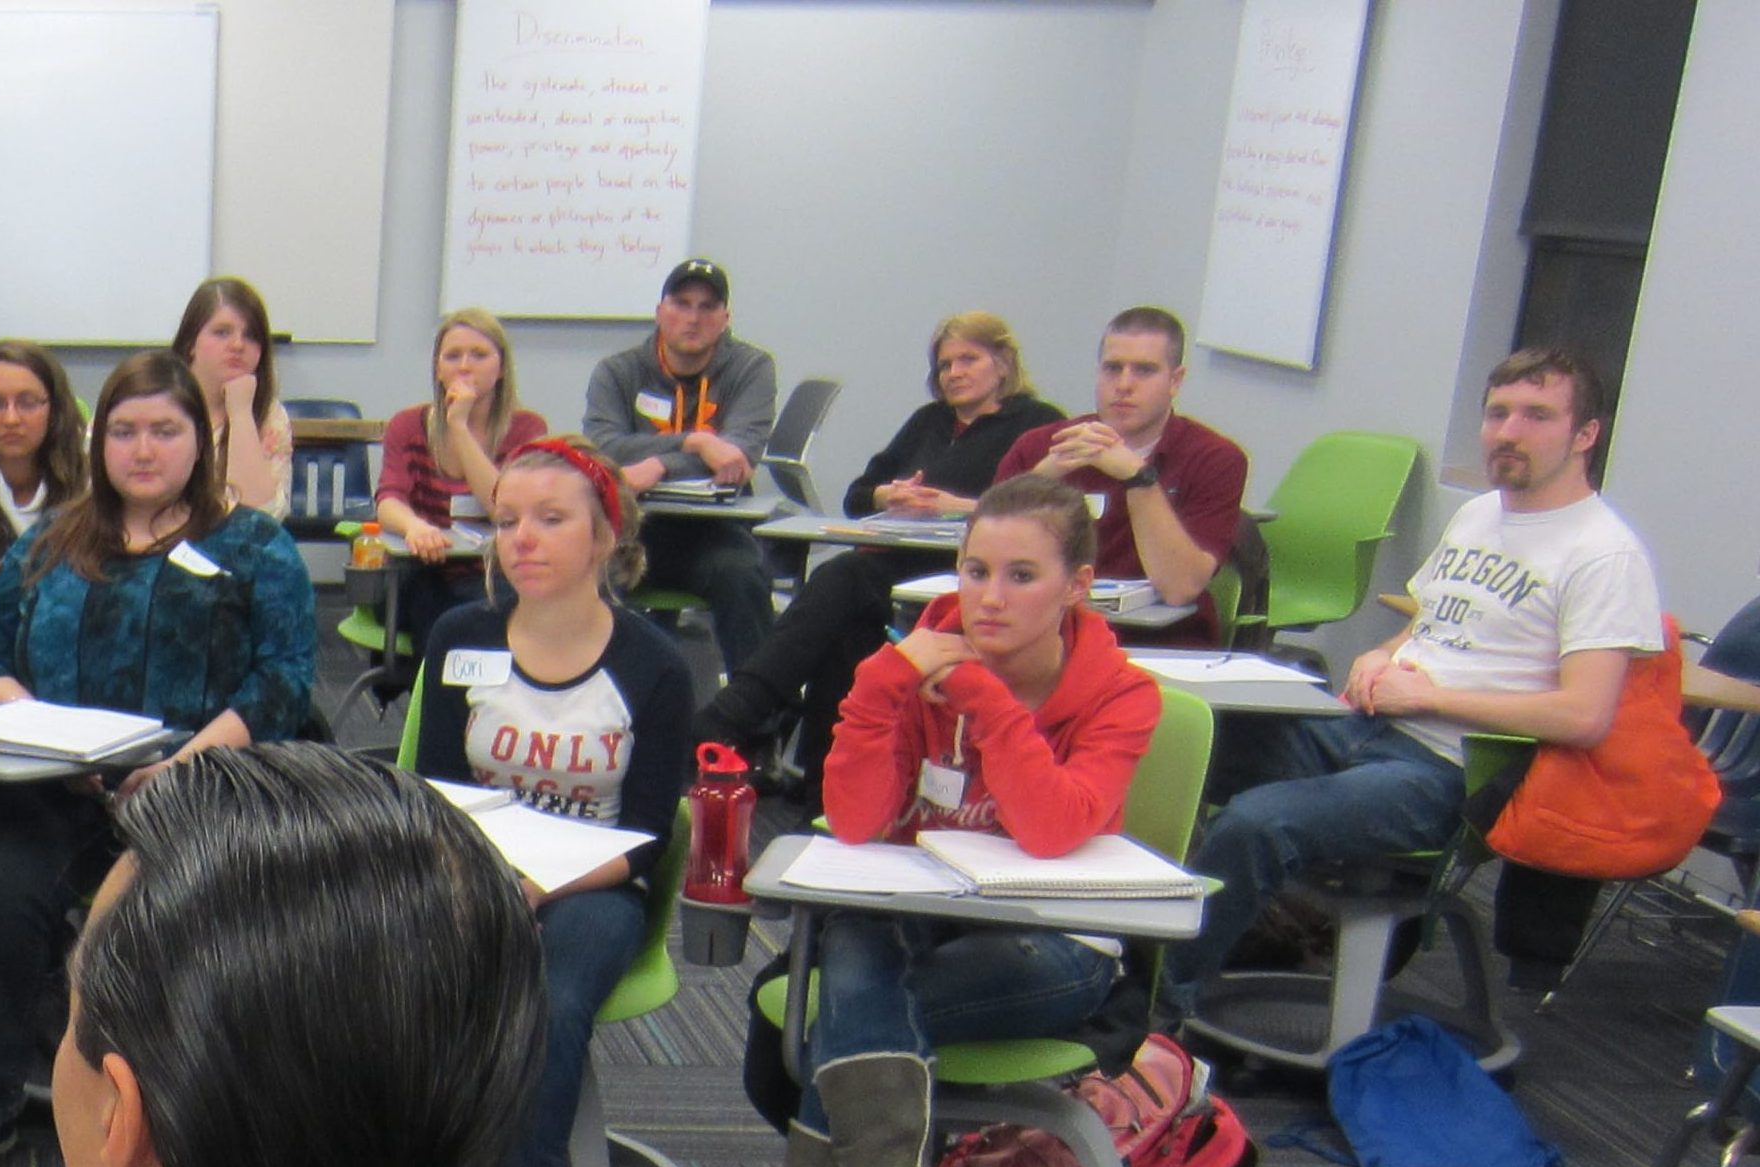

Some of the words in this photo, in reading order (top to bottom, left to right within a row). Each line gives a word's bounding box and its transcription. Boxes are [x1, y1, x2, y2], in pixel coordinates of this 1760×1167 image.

[1431, 548, 1543, 609] REGON
[1436, 595, 1471, 624] UO
[452, 652, 483, 679] Cori
[490, 725, 623, 774] ONLY
